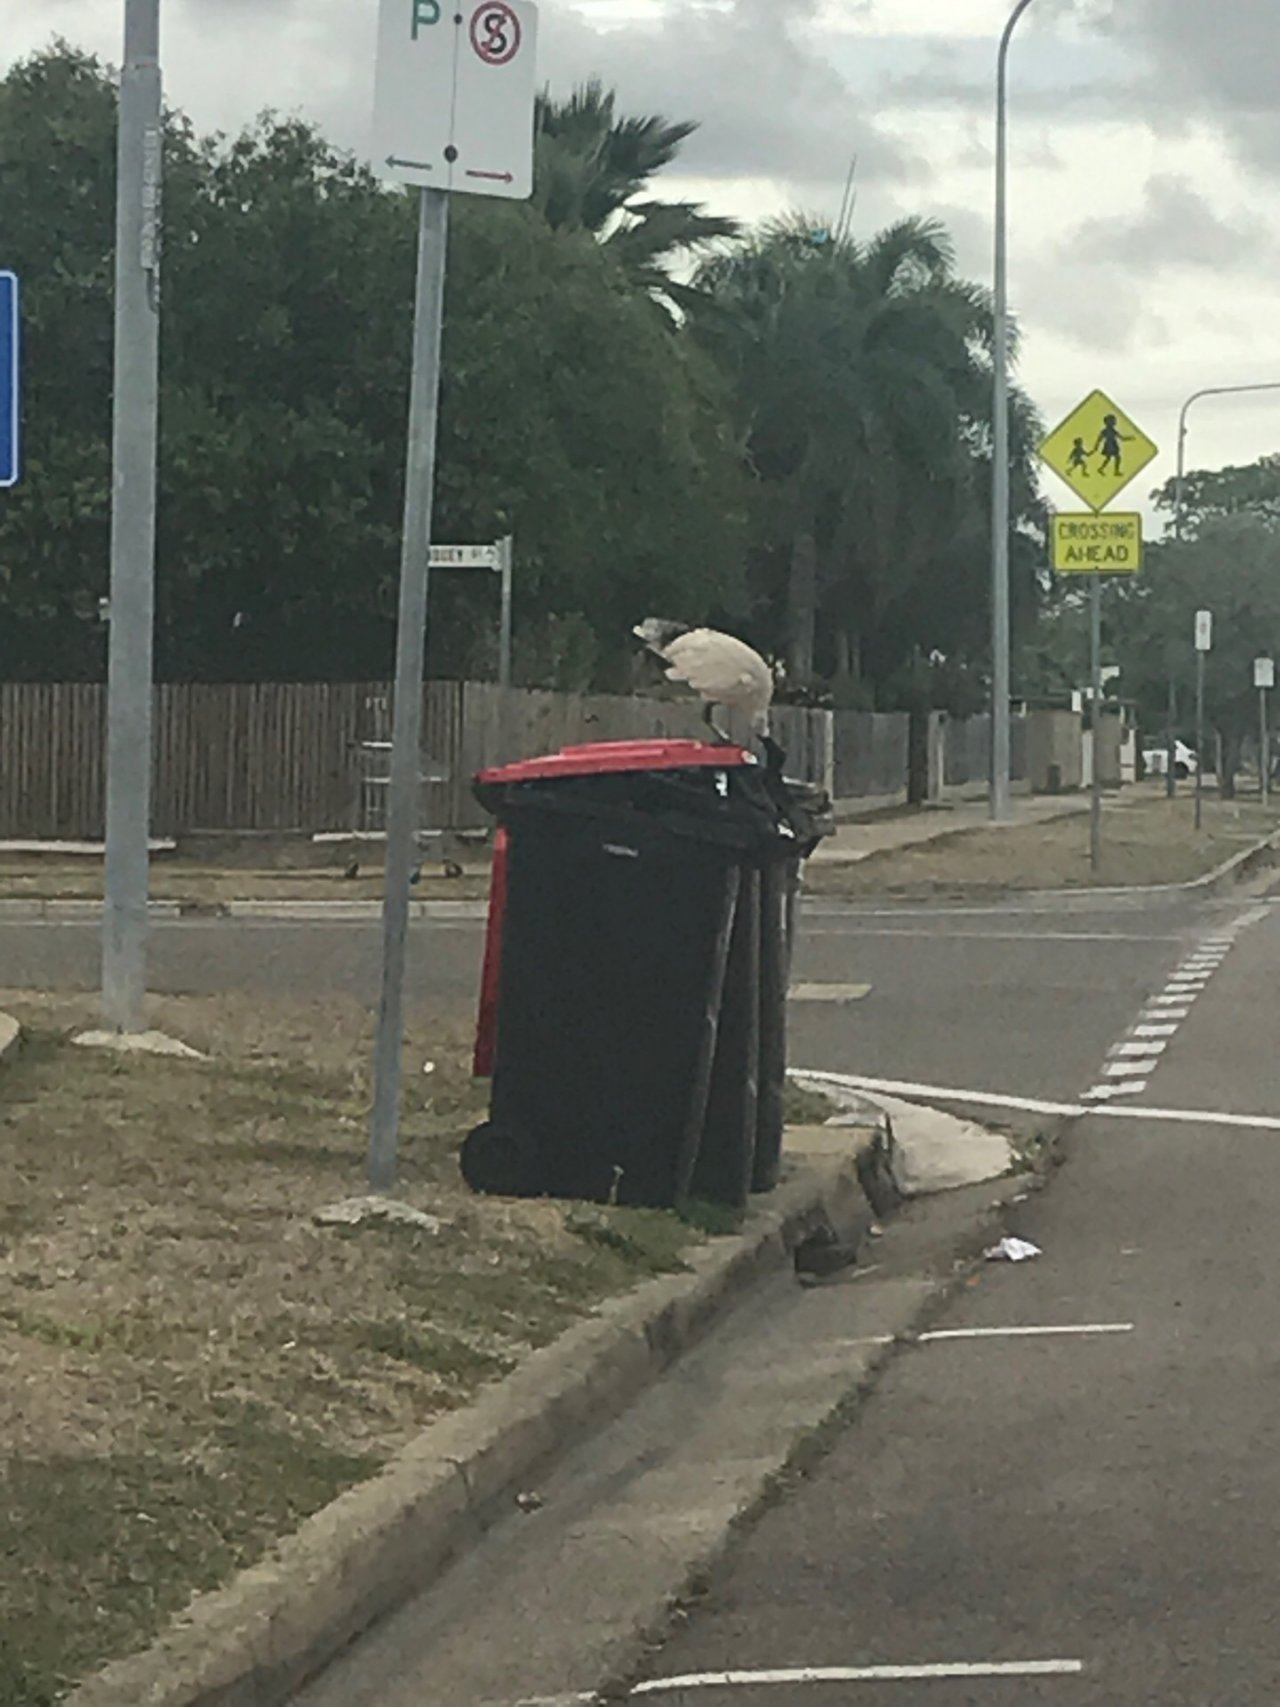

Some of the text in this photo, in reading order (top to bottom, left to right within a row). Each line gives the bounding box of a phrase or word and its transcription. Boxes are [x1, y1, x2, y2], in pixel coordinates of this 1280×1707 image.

[411, 0, 441, 40] P
[1058, 522, 1135, 540] CROSSING
[1064, 544, 1130, 562] AHEAD
